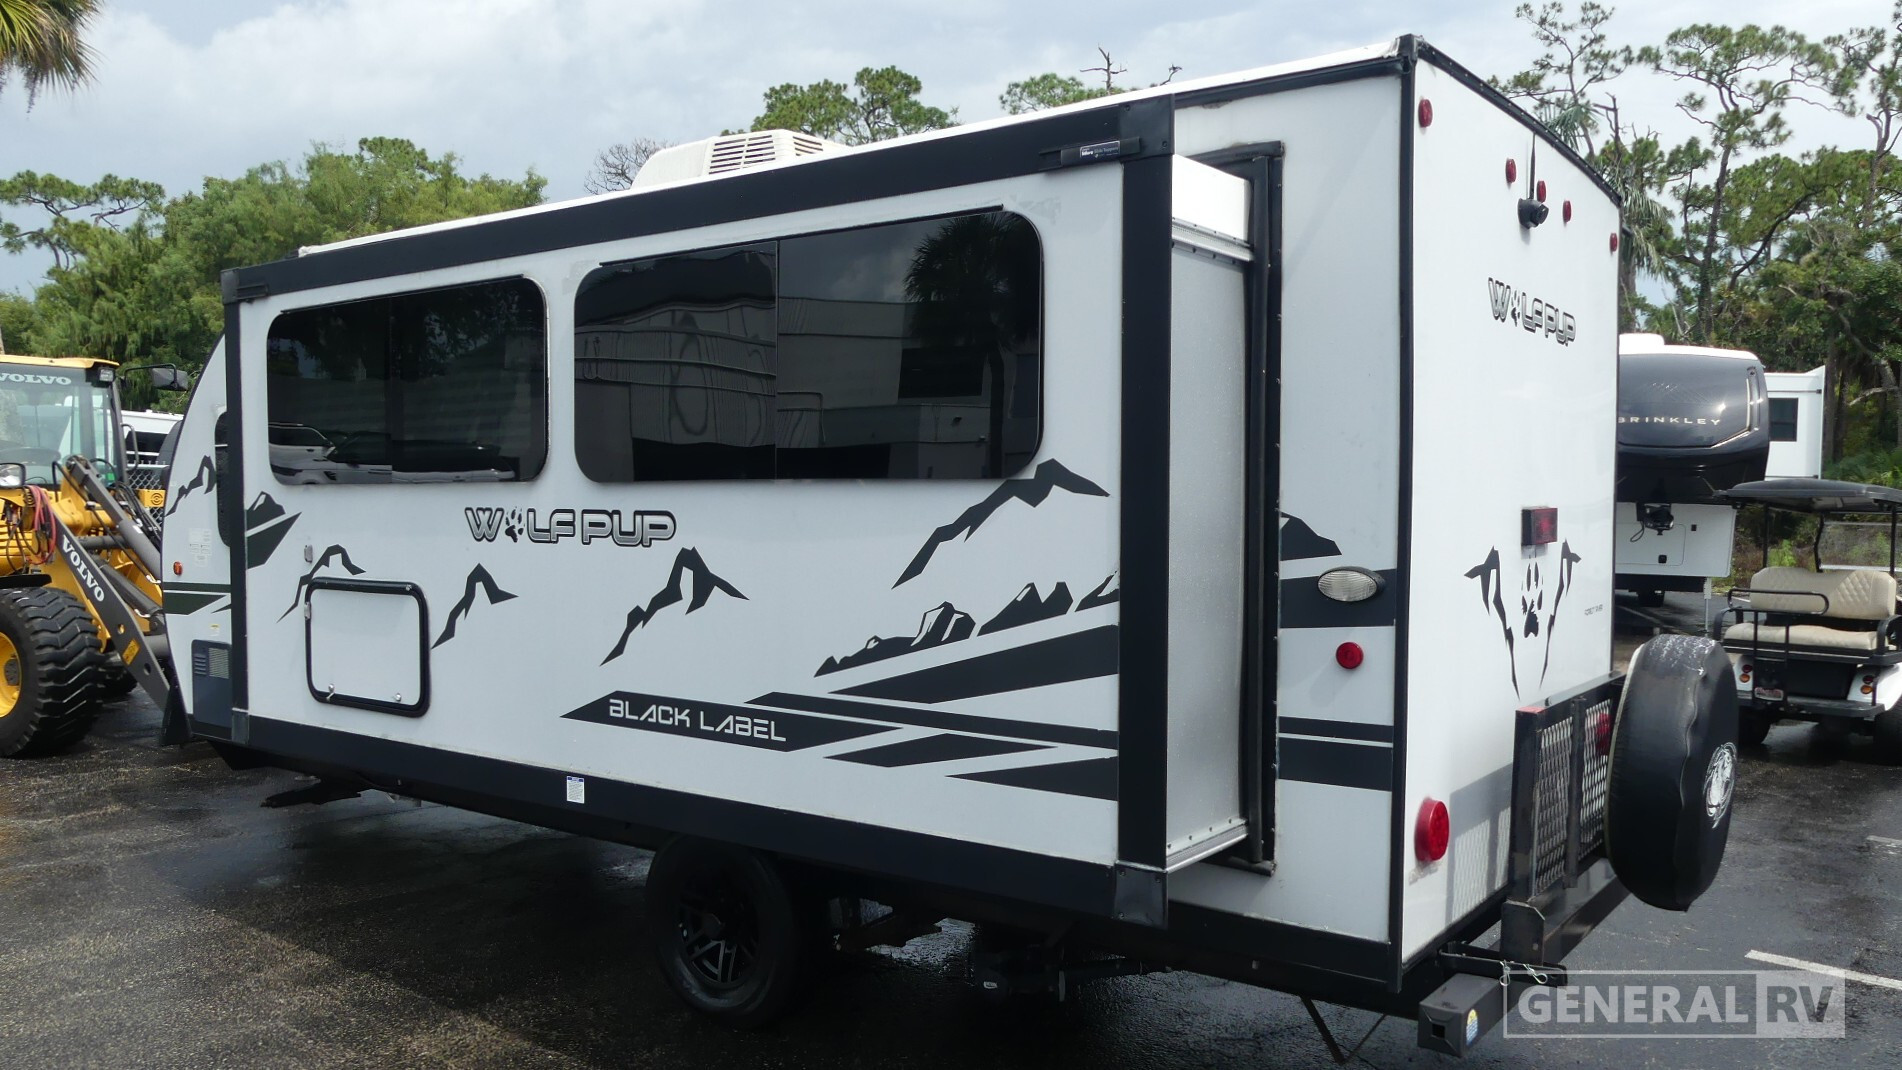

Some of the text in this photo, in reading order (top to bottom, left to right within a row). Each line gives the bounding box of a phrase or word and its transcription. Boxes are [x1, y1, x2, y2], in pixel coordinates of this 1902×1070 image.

[1488, 277, 1576, 347] WLF PUP
[1618, 416, 1720, 426] BRINKLEY
[464, 506, 677, 547] WLF PUP
[62, 534, 105, 602] VOLVO
[609, 699, 787, 742] BLACK LABEL
